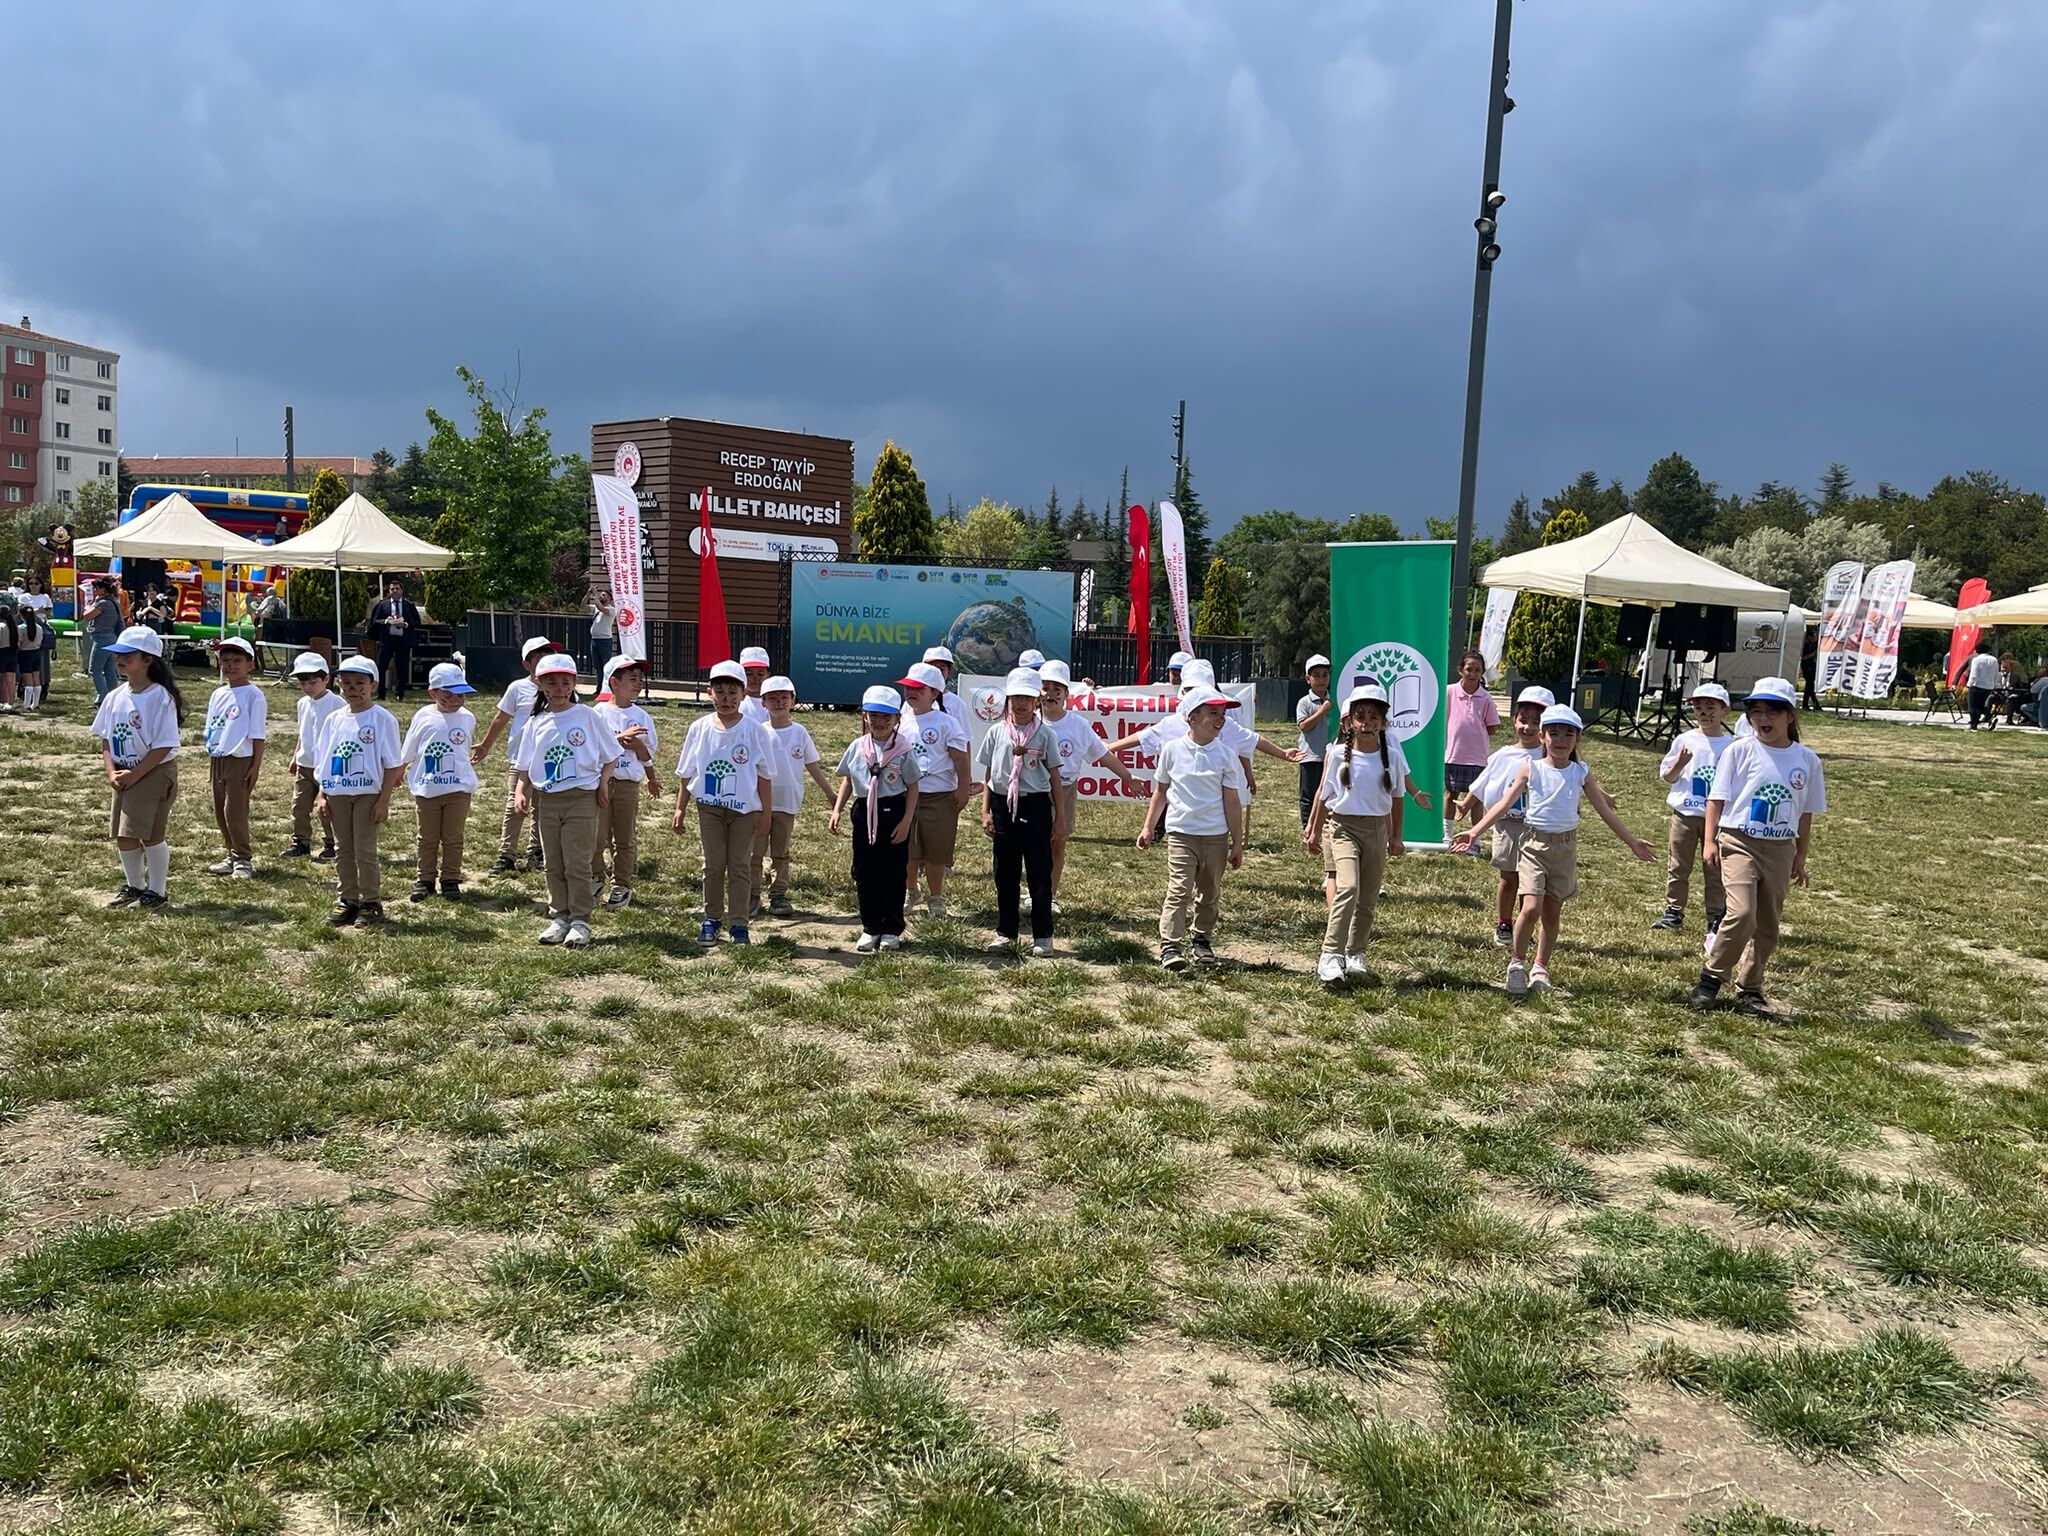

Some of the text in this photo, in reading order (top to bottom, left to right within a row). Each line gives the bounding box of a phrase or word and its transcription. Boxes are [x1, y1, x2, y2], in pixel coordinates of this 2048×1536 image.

[720, 451, 816, 476] RECEP TAYYİP
[734, 471, 802, 492] ERDOĞAN
[689, 486, 840, 525] MİLLET BAHÇESİ
[642, 556, 655, 570] TİM
[816, 603, 890, 619] DÜNYA BİZE
[816, 621, 925, 645] EMANET
[1858, 658, 1873, 695] KAHVE
[1065, 691, 1180, 716] KİŞEHİR
[1118, 718, 1156, 740] İK
[1387, 720, 1420, 728] KULLAR
[321, 777, 374, 789] Eko-Okullar
[1077, 777, 1154, 798] OKUL
[1738, 823, 1796, 838] Eko-Okulla
